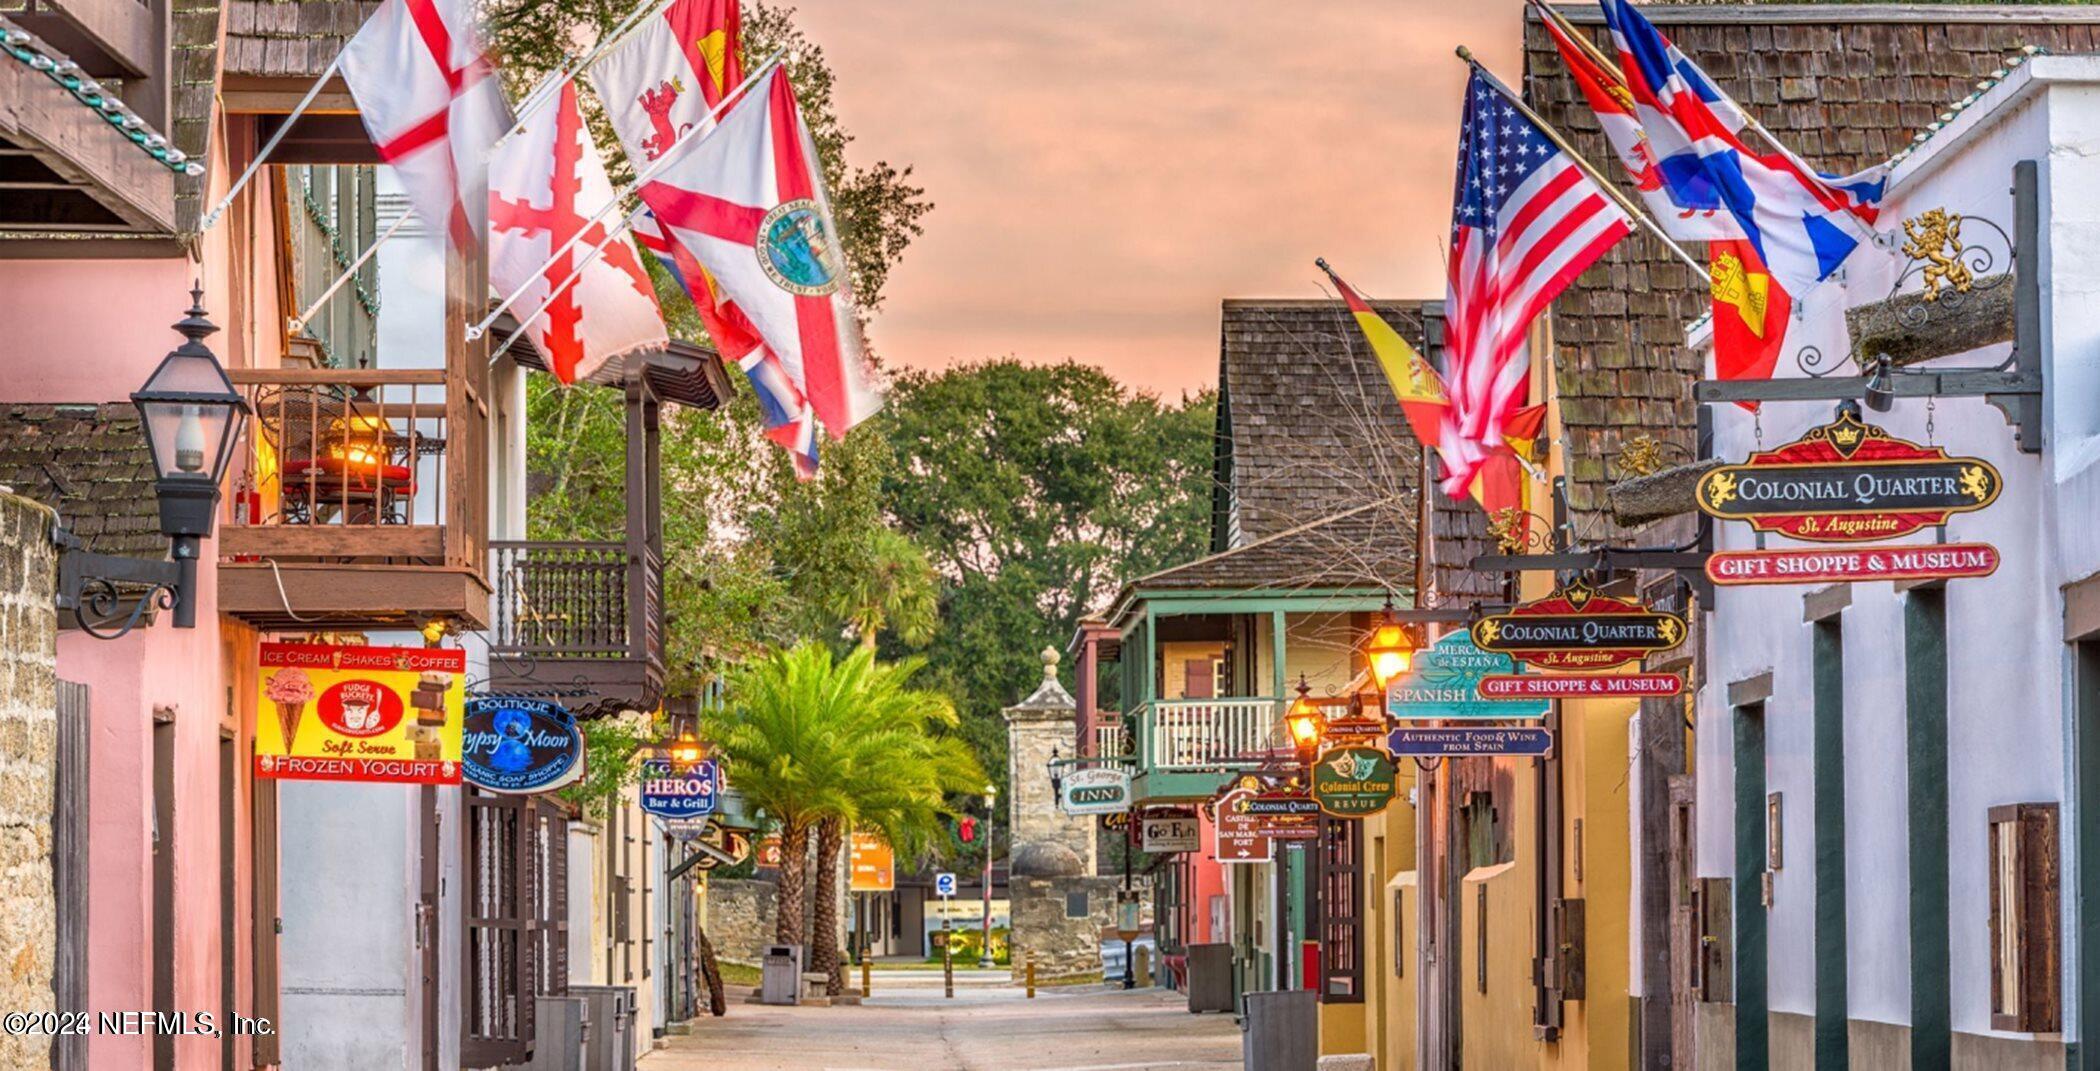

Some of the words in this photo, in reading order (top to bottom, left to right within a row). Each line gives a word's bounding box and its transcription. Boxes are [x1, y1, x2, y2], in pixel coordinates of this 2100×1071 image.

[1738, 477, 1848, 500] COLONIAL
[1853, 473, 1958, 504] QUARTER
[1798, 516, 1820, 534] St.
[1825, 514, 1898, 534] Augustine
[1719, 558, 1769, 576] GIFT
[1776, 555, 1860, 574] SHOPPE
[1867, 557, 1885, 571] &
[1892, 552, 1986, 570] MUSEUM
[1501, 622, 1579, 641] COLONIAL
[1582, 620, 1656, 644] QUARTER
[263, 651, 284, 663] ICE
[287, 651, 330, 664] CREAM
[343, 653, 391, 666] SHAKES
[409, 655, 459, 669] COFFEE
[1452, 655, 1500, 668] ESPAÑA
[1543, 651, 1559, 664] St.
[1562, 650, 1614, 665] Augustine
[343, 684, 371, 692] FUDGE
[1488, 680, 1523, 692] GIFT
[1527, 679, 1587, 692] SHOPPE
[1589, 679, 1602, 691] &
[1608, 678, 1674, 691] MUSEUM
[1393, 689, 1466, 702] SPANISH
[477, 699, 550, 713] BOUTIQUE
[524, 729, 569, 747] Moon
[1402, 732, 1461, 742] AUTHENTIC
[1507, 732, 1537, 742] WINE
[322, 740, 354, 756] Soft
[357, 741, 396, 755] Serve
[1443, 743, 1470, 751] FROM
[1474, 741, 1504, 751] SPAIN
[276, 756, 354, 774] FROZEN
[359, 759, 439, 776] YOGURT
[1070, 775, 1084, 786] St.
[1087, 770, 1122, 784] George
[645, 779, 712, 796] HEROS
[1320, 781, 1360, 793] Colonial
[1363, 781, 1390, 792] Crew
[1080, 789, 1114, 801] INN
[649, 798, 667, 808] Bar
[670, 798, 680, 808] &
[683, 798, 708, 808] Grill
[1334, 800, 1376, 808] REVUE
[1147, 824, 1168, 839] Go
[1233, 838, 1253, 846] FORT
